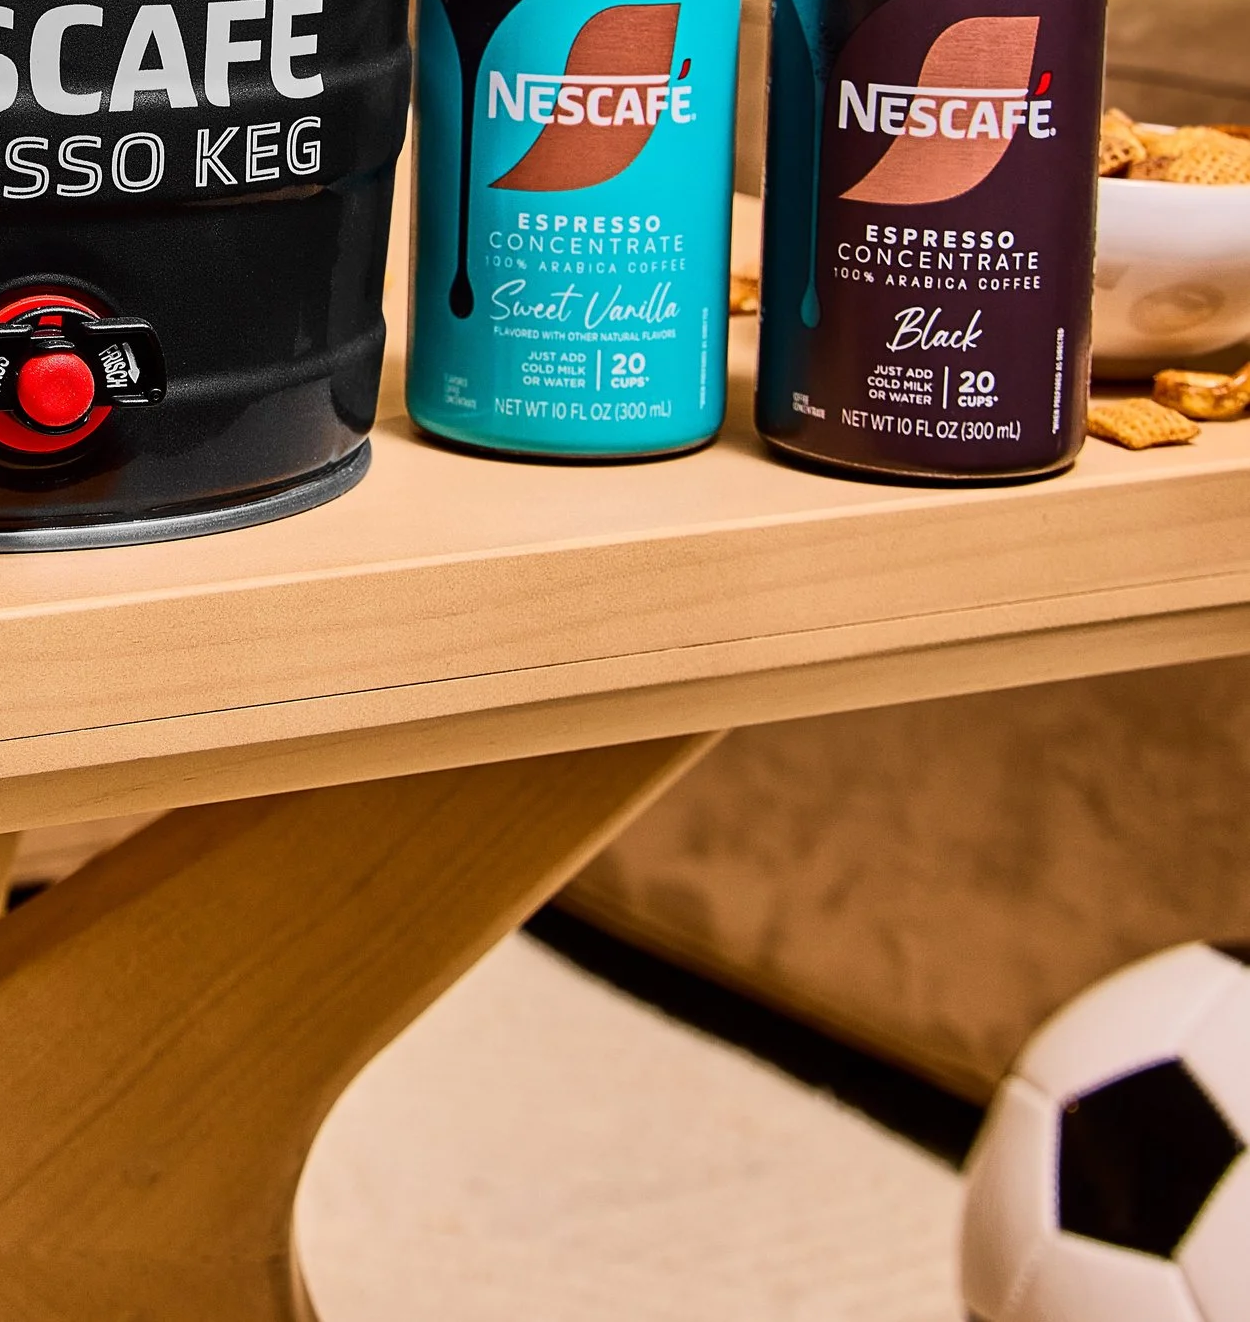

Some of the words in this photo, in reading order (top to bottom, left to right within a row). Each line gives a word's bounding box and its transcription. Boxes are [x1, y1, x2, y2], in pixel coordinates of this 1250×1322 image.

[487, 58, 693, 126] NESCAFÉ
[838, 71, 1054, 139] NESCAFÉ
[195, 116, 322, 188] KEG
[518, 212, 661, 234] ESPRESSO
[489, 232, 685, 255] CONCENTRATE
[866, 224, 1015, 249] ESPRESSO
[485, 255, 527, 270] 100%
[539, 261, 617, 274] ARABICA
[628, 258, 686, 274] COFFEE
[838, 243, 1039, 271] CONCENTRATE
[834, 266, 875, 283] 100%
[885, 275, 967, 291] ARABICA
[978, 276, 1041, 291] COFFEE
[490, 279, 583, 323] Sweet
[584, 282, 681, 330] Vanilla
[494, 326, 539, 341] FLAVORED
[542, 330, 565, 342] WITH
[568, 331, 598, 342] OTHER
[600, 331, 640, 343] NATURAL
[642, 329, 676, 341] FLAVORS
[886, 306, 982, 352] Black
[98, 343, 128, 388] FRISCH
[527, 351, 557, 363] JUST
[560, 352, 586, 363] ADD
[611, 353, 646, 375] 20
[521, 363, 555, 375] COLD
[557, 364, 586, 375] MILK
[873, 364, 903, 377] JUST
[905, 367, 933, 379] ADD
[522, 375, 541, 387] OR
[543, 376, 586, 388] WATER
[867, 376, 900, 389] COLD
[903, 380, 933, 392] MILK
[958, 370, 995, 393] 20
[869, 389, 886, 401] OR
[888, 391, 932, 405] WATER
[495, 397, 521, 417] NET
[523, 399, 548, 418] WT
[552, 402, 567, 419] 10
[570, 403, 588, 420] FL
[590, 403, 612, 421] OZ
[615, 402, 647, 422] (300
[650, 399, 672, 419] mL)
[841, 408, 869, 428] NET
[870, 412, 894, 433] WT
[897, 417, 912, 435] 10
[915, 419, 934, 437] FL
[936, 420, 959, 439] OZ
[961, 419, 994, 441] (300
[997, 420, 1021, 441] mL)
